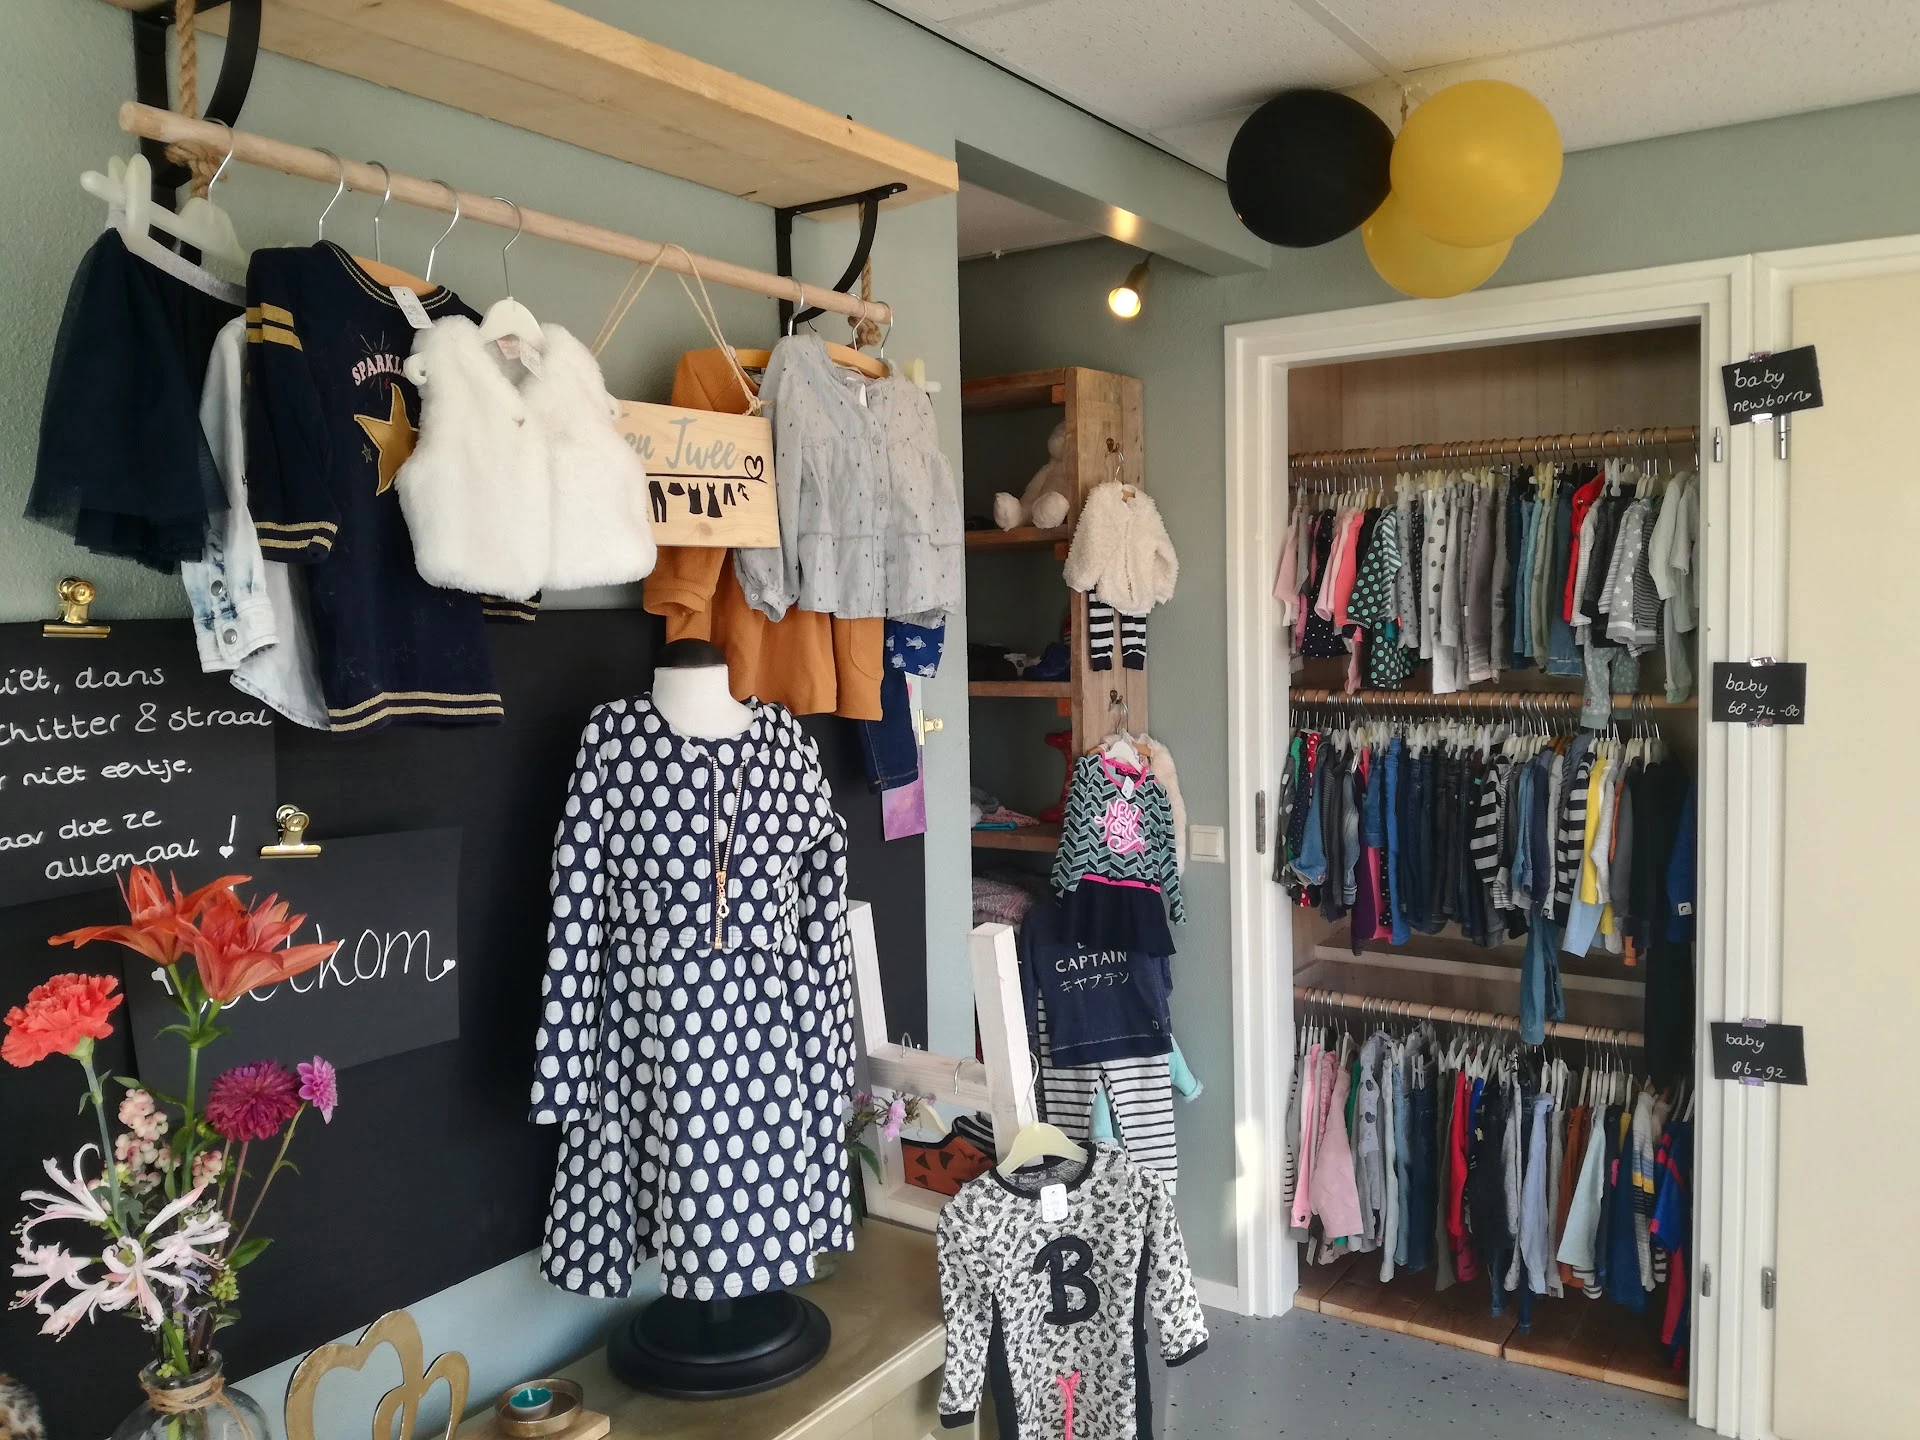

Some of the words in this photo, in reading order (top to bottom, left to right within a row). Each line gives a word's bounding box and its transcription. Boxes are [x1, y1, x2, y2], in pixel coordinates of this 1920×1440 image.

[351, 353, 406, 386] SPARKL
[1733, 367, 1785, 390] baby
[1732, 390, 1812, 413] newborn
[0, 666, 60, 695] iet,
[75, 666, 165, 689] dans
[1725, 673, 1768, 699] baby
[168, 705, 272, 732] straal
[22, 764, 86, 787] niet
[1104, 799, 1142, 822] NEW
[0, 830, 44, 851] aar
[58, 818, 113, 841] doe
[122, 810, 163, 831] ze
[1094, 816, 1140, 842] YORK
[44, 838, 200, 881] allemaal
[1055, 950, 1127, 973] CAPTAIN
[1725, 1033, 1765, 1054] baby
[1032, 1235, 1101, 1326] B
